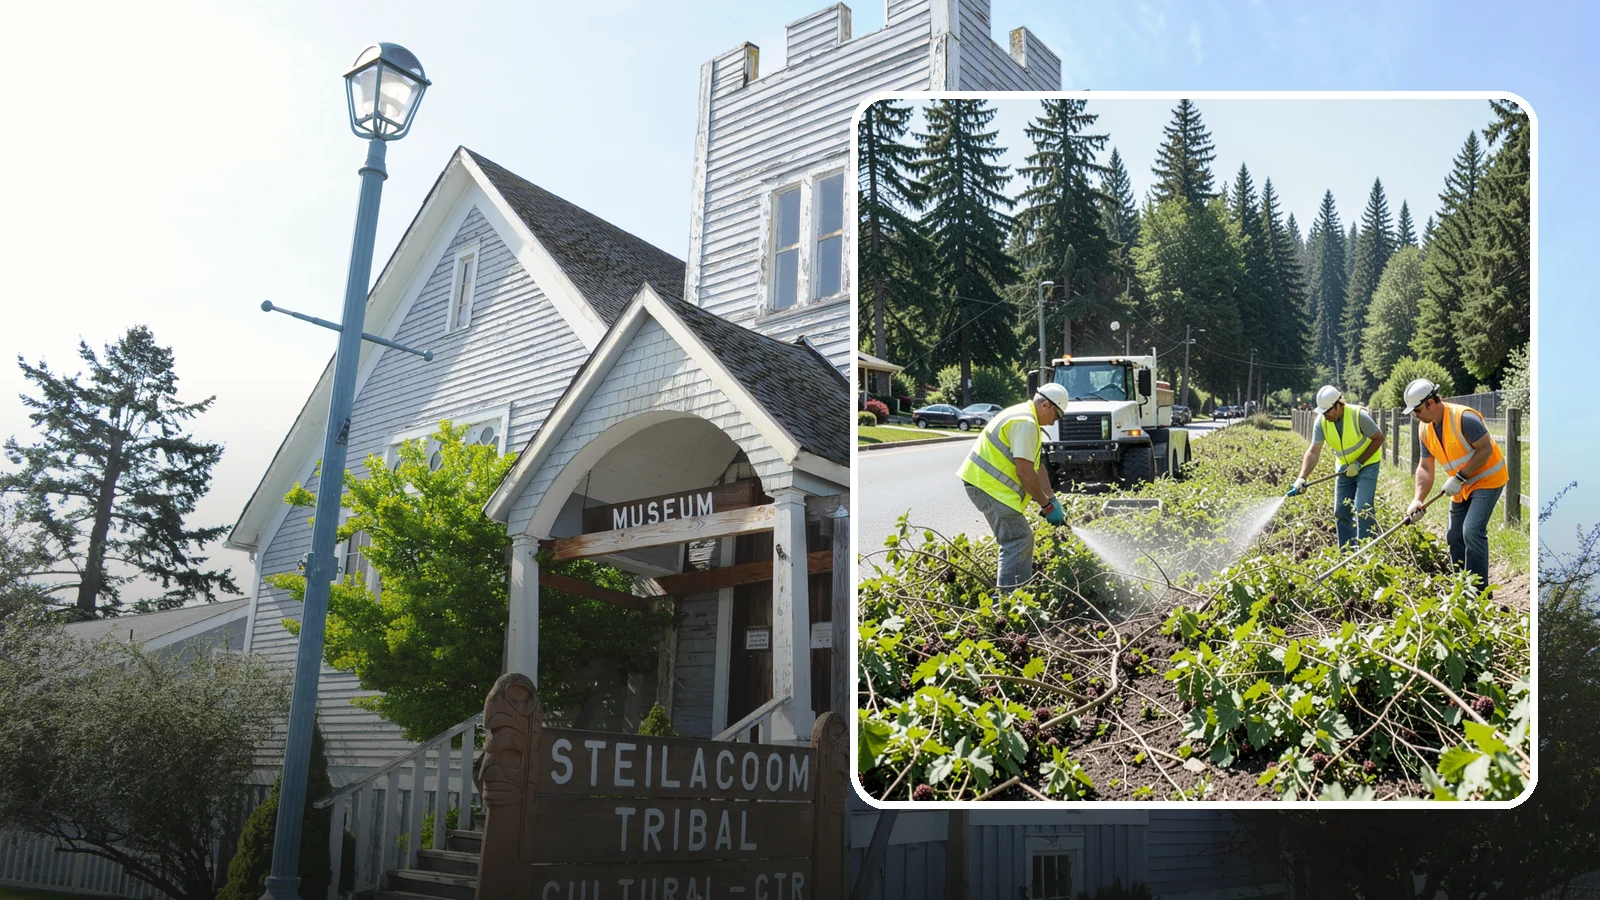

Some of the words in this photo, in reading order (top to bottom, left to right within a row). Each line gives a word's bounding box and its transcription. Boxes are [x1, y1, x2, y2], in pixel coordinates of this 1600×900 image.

[612, 491, 714, 530] MUSEUM
[550, 738, 809, 792] STEILACOOM
[615, 806, 757, 852] TRIBAL
